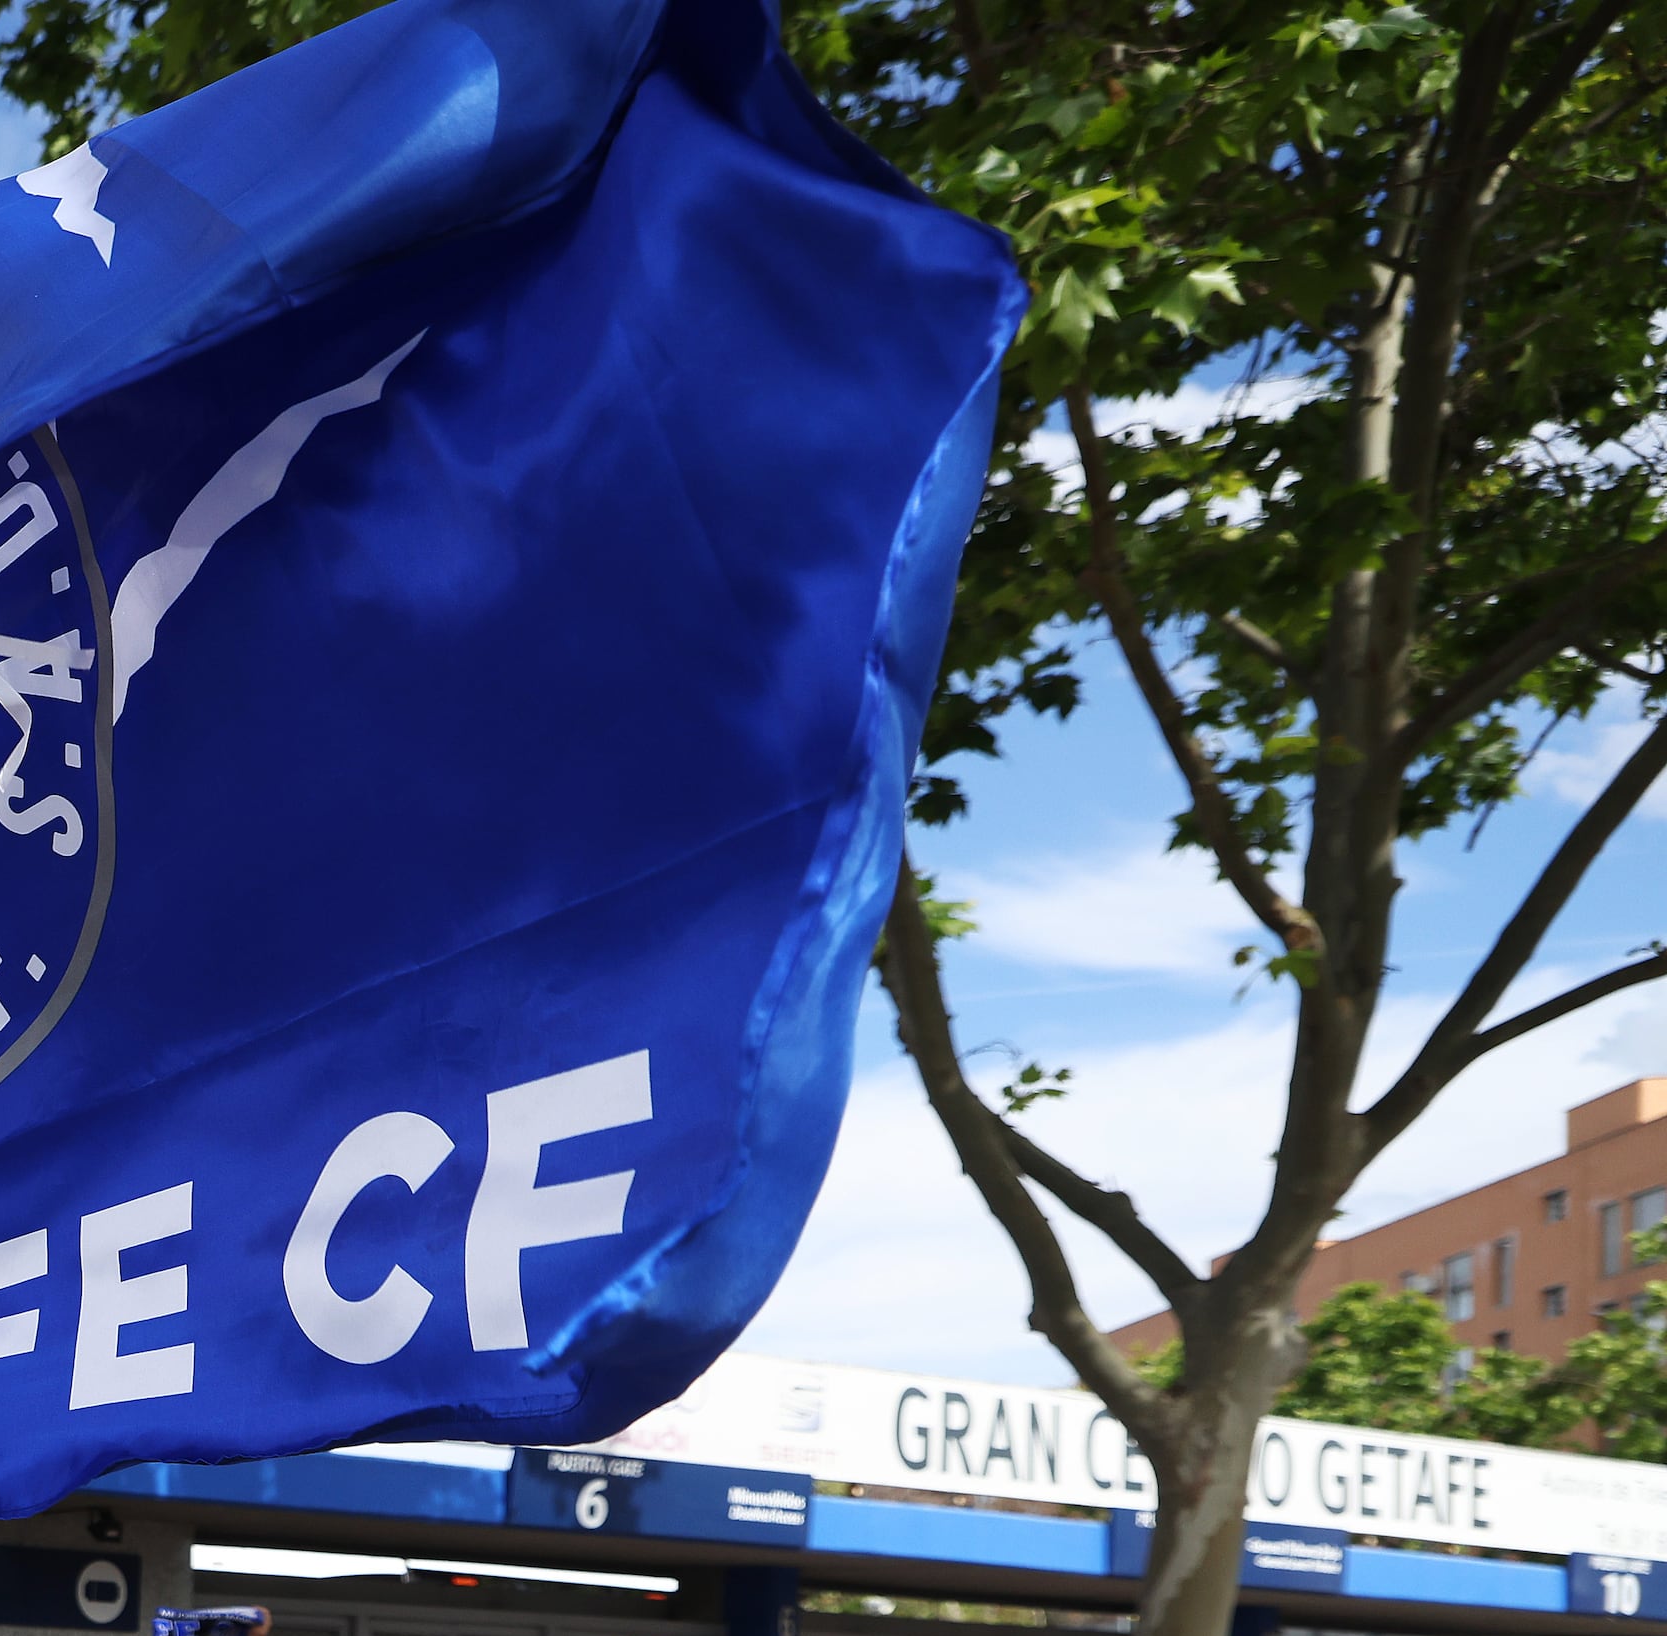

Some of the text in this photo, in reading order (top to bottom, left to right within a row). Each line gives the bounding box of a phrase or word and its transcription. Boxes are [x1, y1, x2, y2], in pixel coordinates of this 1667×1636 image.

[281, 1049, 654, 1366] CF
[574, 1477, 610, 1530] 6
[896, 1386, 1061, 1485] GRAN
[1317, 1438, 1494, 1530] GETAFE
[1599, 1571, 1642, 1617] 10
